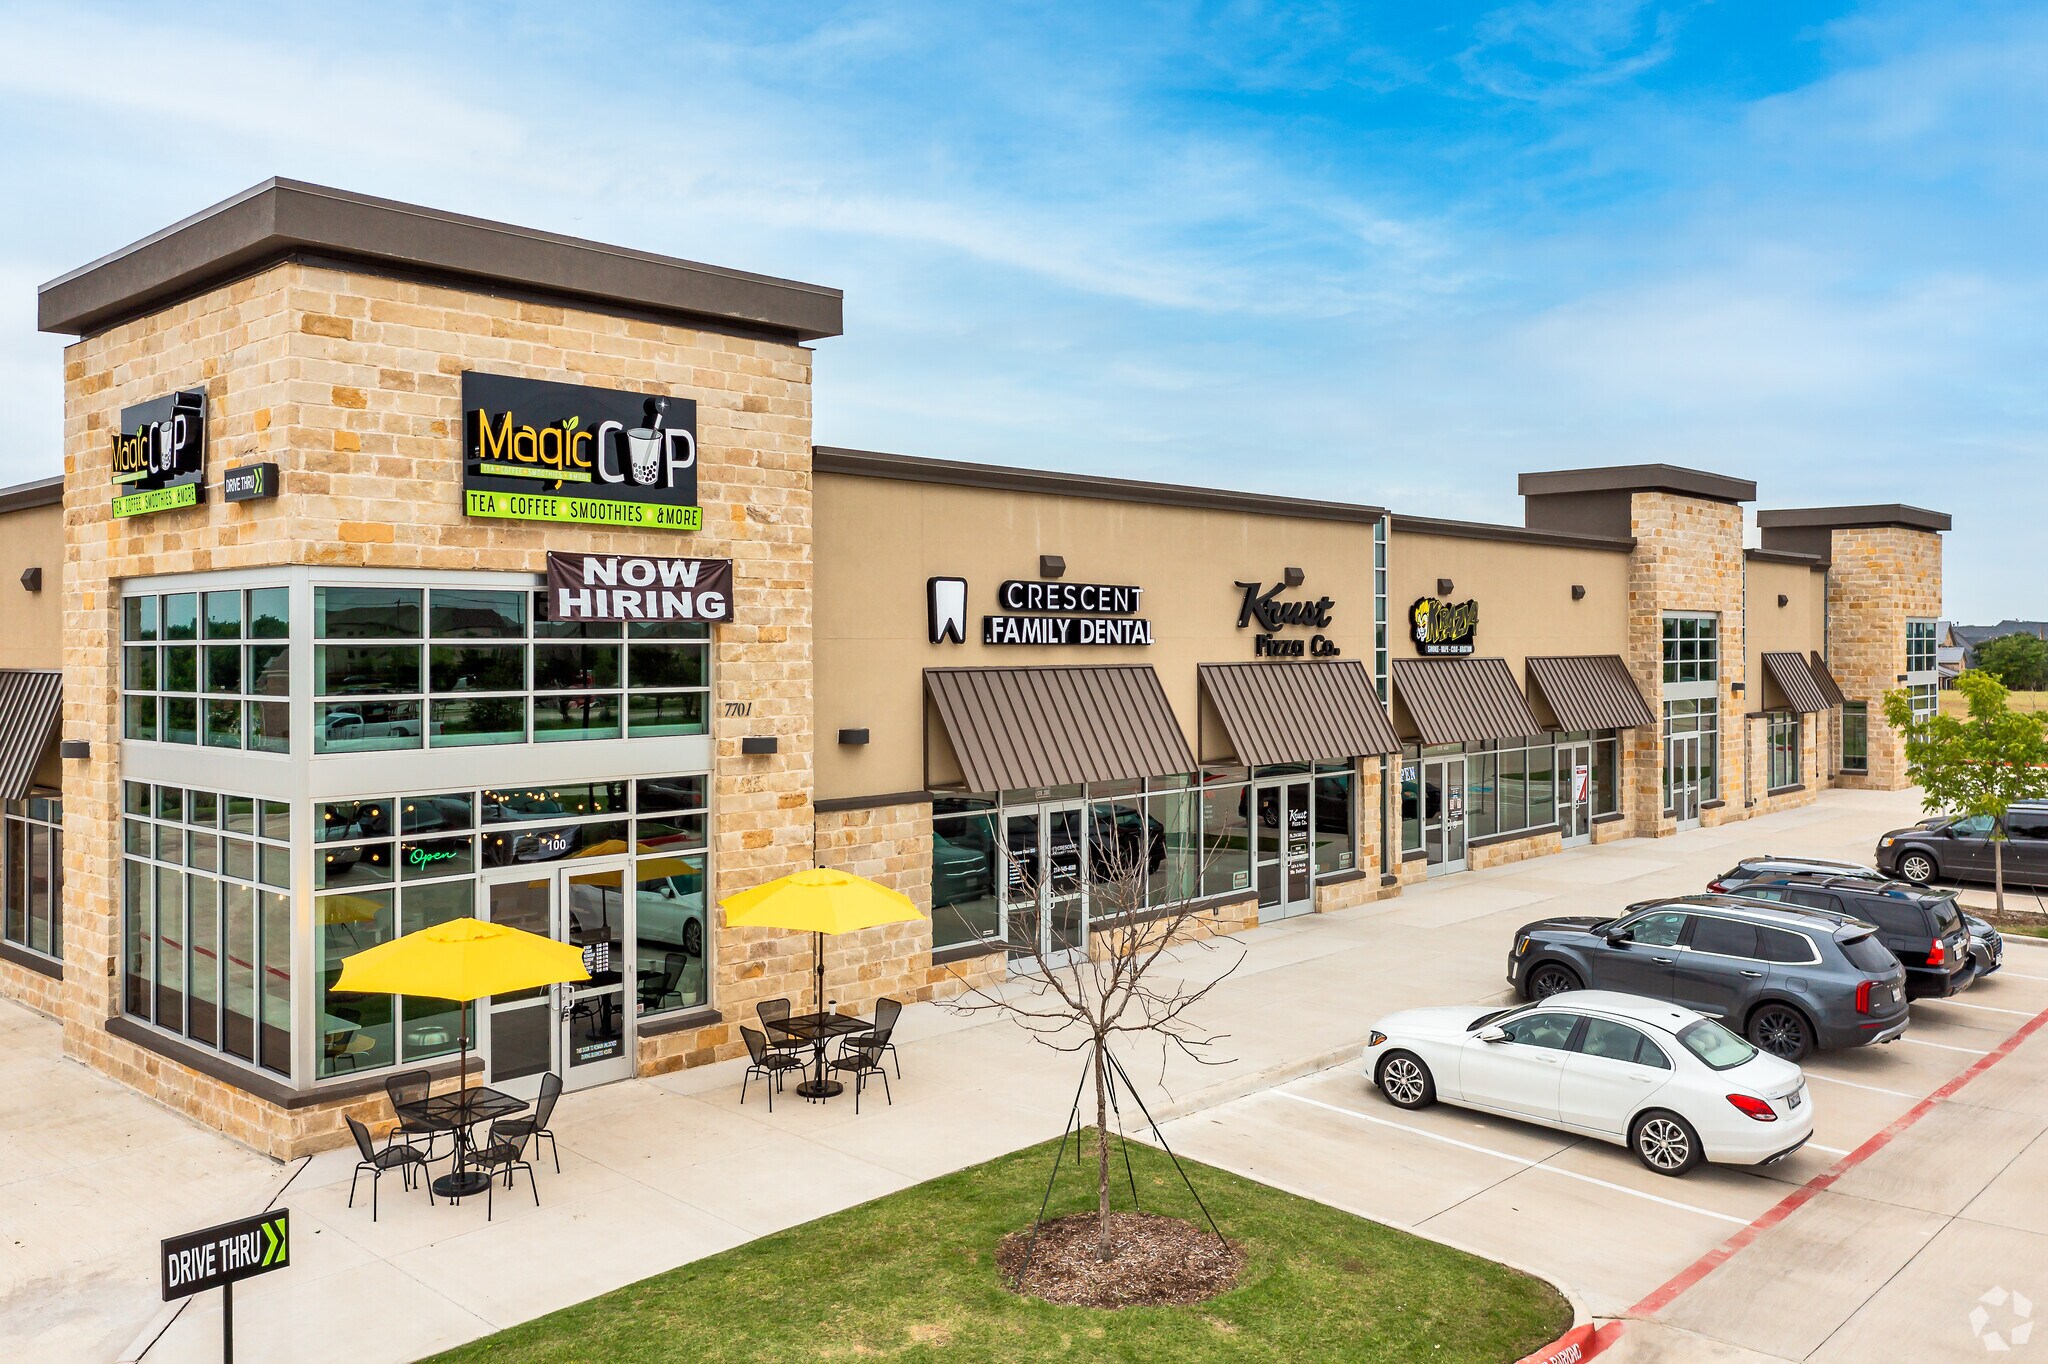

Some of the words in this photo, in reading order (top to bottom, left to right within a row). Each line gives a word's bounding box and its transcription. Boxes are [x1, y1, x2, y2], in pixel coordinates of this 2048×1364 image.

[112, 425, 147, 488] Magic
[480, 408, 592, 490] Magic
[226, 477, 240, 493] DRIVE
[241, 474, 255, 490] THRU
[500, 466, 525, 476] COFFEE
[528, 468, 563, 479] SMOOTHIES
[470, 494, 496, 513] TEA
[510, 497, 558, 518] COFFEE
[571, 501, 643, 523] SMOOTHIES
[584, 557, 701, 588] NOW
[559, 588, 726, 618] HIRING
[1008, 583, 1145, 612] CRESCENT
[1234, 581, 1336, 632] Krust
[992, 617, 1071, 643] FAMILY
[1080, 619, 1155, 644] DENTAL
[1255, 634, 1305, 657] Pizza
[1311, 635, 1340, 657] Co.
[725, 702, 753, 717] 7701
[1401, 766, 1416, 783] PEN
[547, 839, 566, 851] 100
[411, 849, 457, 871] Open
[168, 1242, 216, 1287] DRIVE
[219, 1230, 261, 1272] THRU
